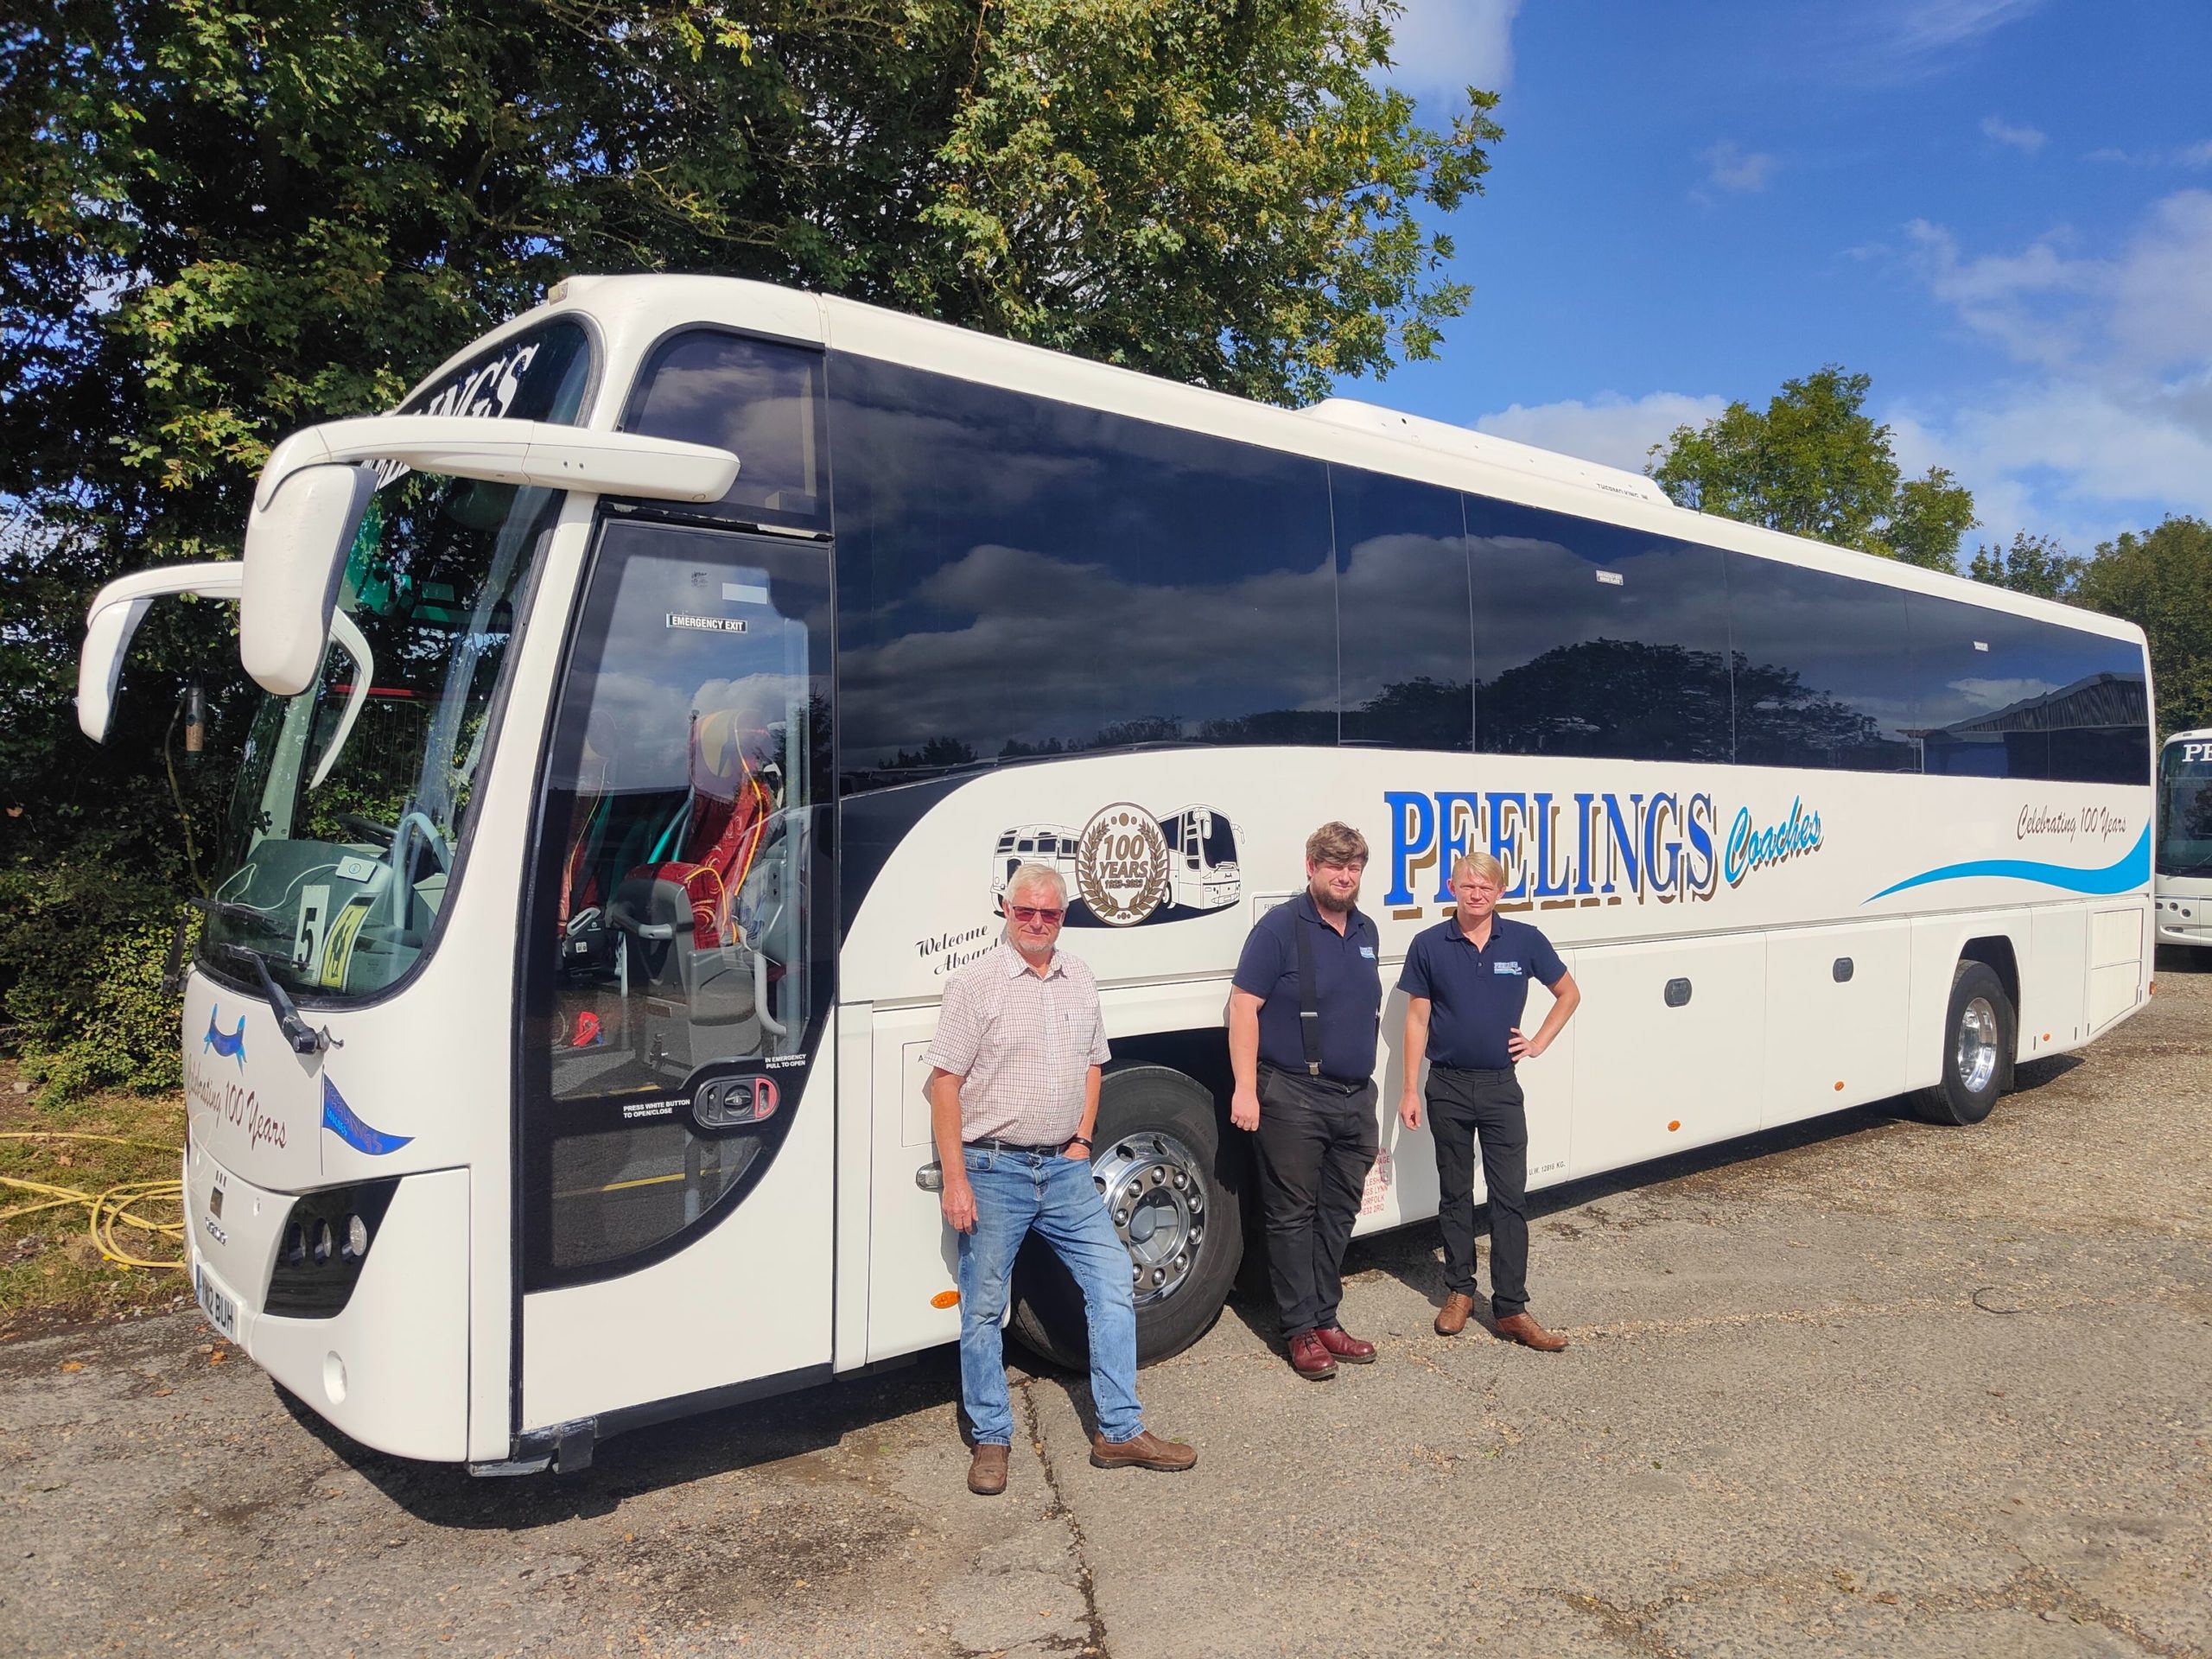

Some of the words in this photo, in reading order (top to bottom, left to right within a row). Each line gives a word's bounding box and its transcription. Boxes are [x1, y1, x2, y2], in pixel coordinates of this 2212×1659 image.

[671, 616, 724, 629] EMERGENCY
[725, 620, 744, 632] EXIT
[2017, 804, 2076, 844] Celebrating
[2080, 806, 2099, 833] 100
[2100, 805, 2127, 843] Years
[1103, 834, 1145, 861] 100
[1383, 791, 1718, 918] PEELINGS
[1725, 794, 1825, 889] Coaches
[1099, 861, 1148, 879] YEARS
[297, 906, 318, 973] 5
[914, 925, 989, 958] Welcome
[772, 1053, 806, 1062] EMERGENCY
[225, 1080, 245, 1127] 100
[246, 1090, 287, 1152] Years
[623, 1103, 644, 1112] PRESS
[645, 1101, 665, 1110] WHITE
[665, 1098, 690, 1109] BUTTON
[632, 1107, 673, 1118] OPEN/CLOSE
[215, 1292, 233, 1334] BUH
